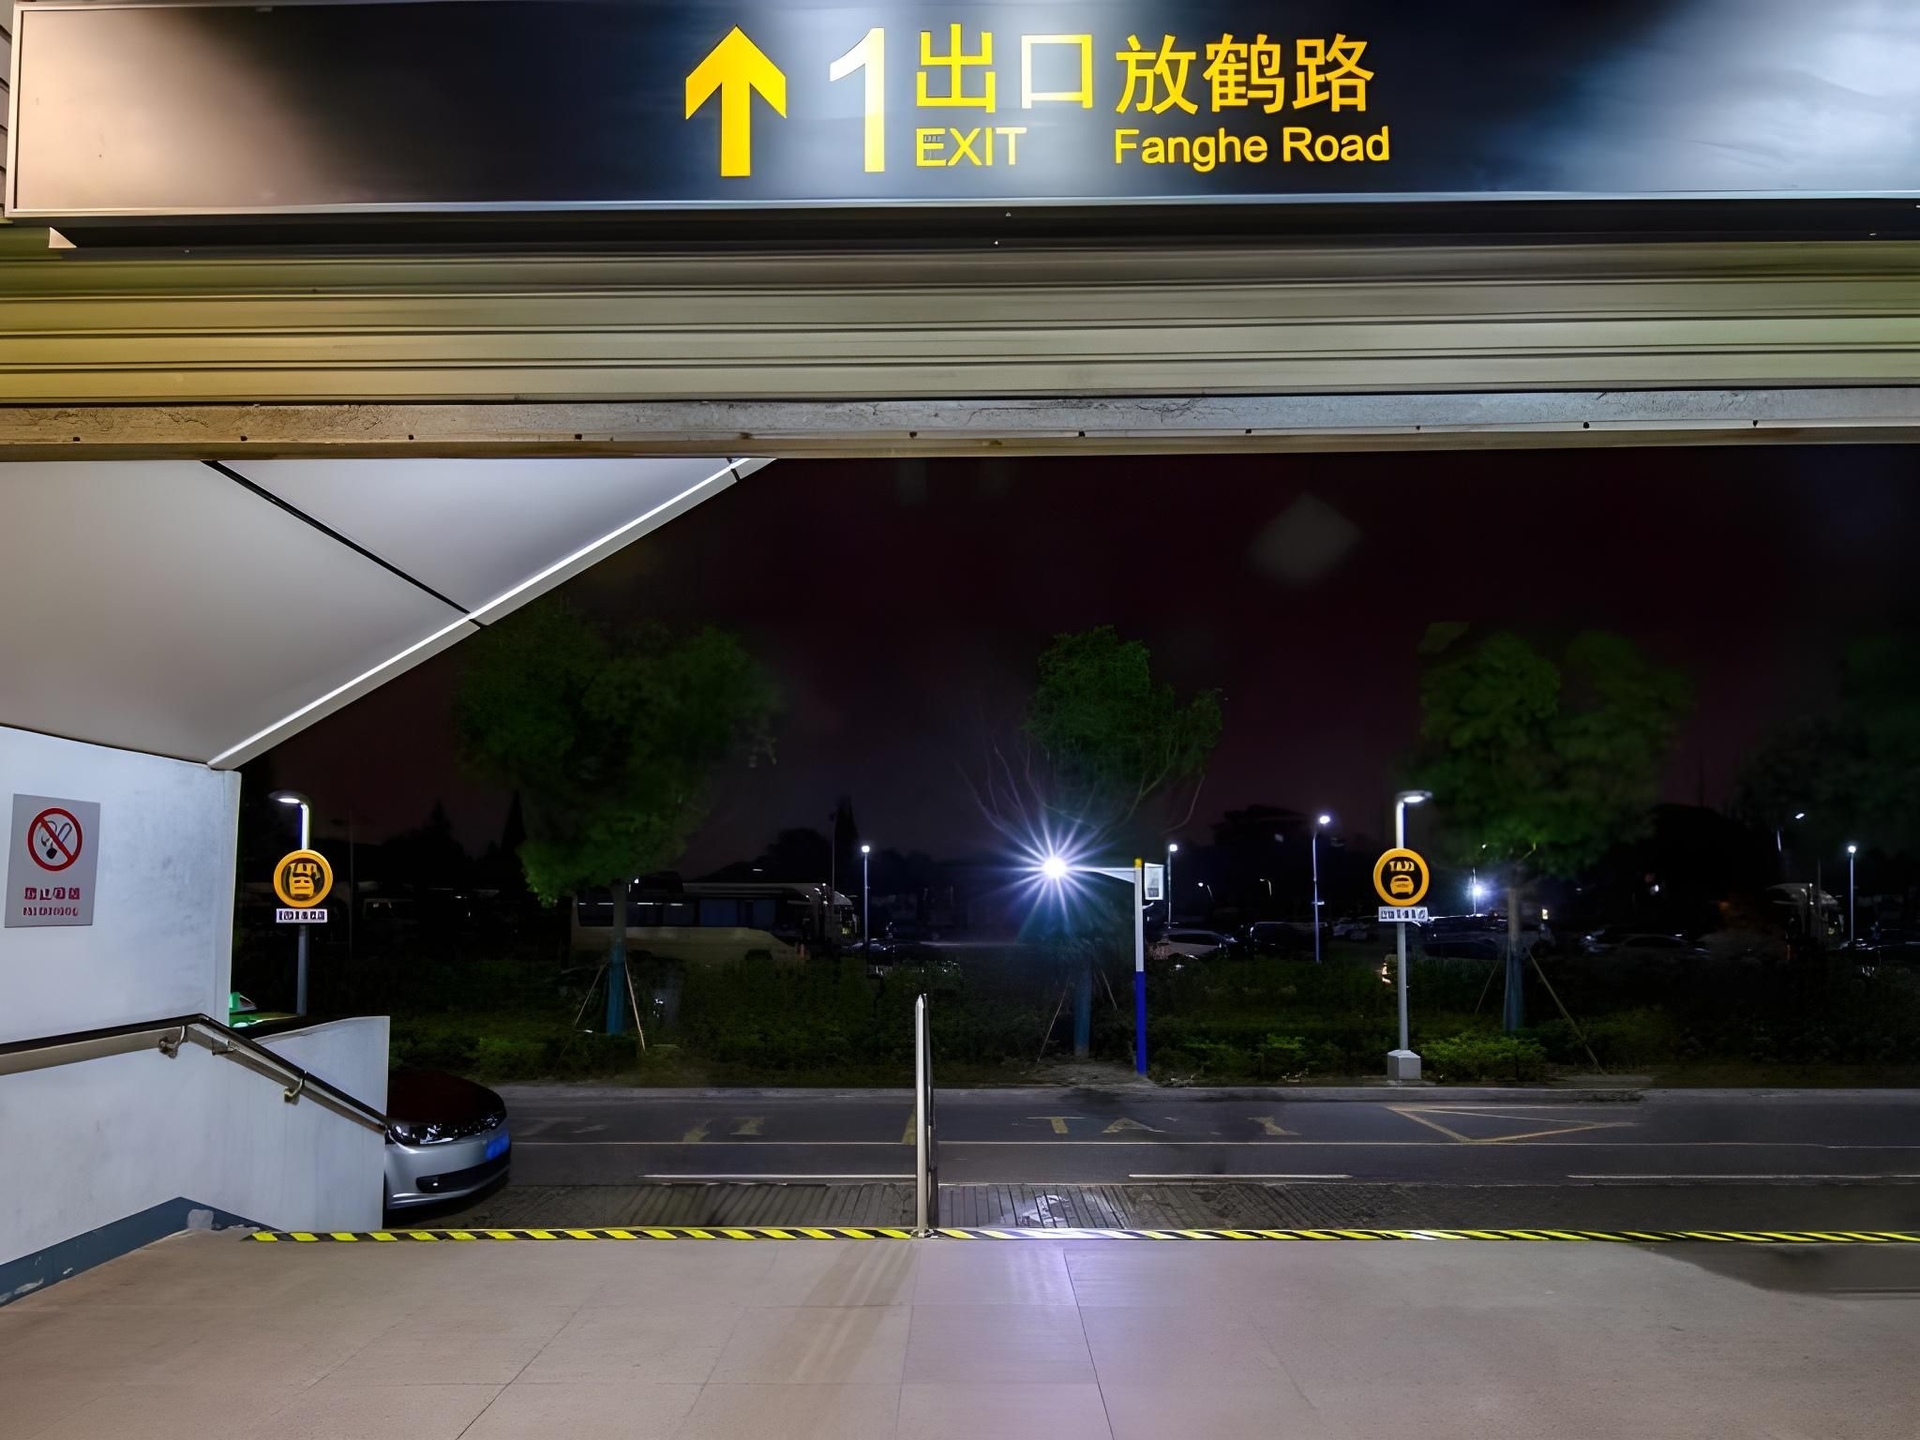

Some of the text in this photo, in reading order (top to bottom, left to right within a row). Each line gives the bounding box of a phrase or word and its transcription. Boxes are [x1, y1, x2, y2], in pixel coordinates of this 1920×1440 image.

[829, 27, 885, 172] 1
[916, 24, 1093, 113] 出口
[1115, 33, 1375, 115] 放鹤路
[916, 127, 1027, 167] EXIT
[1114, 125, 1390, 173] Fanghe Road
